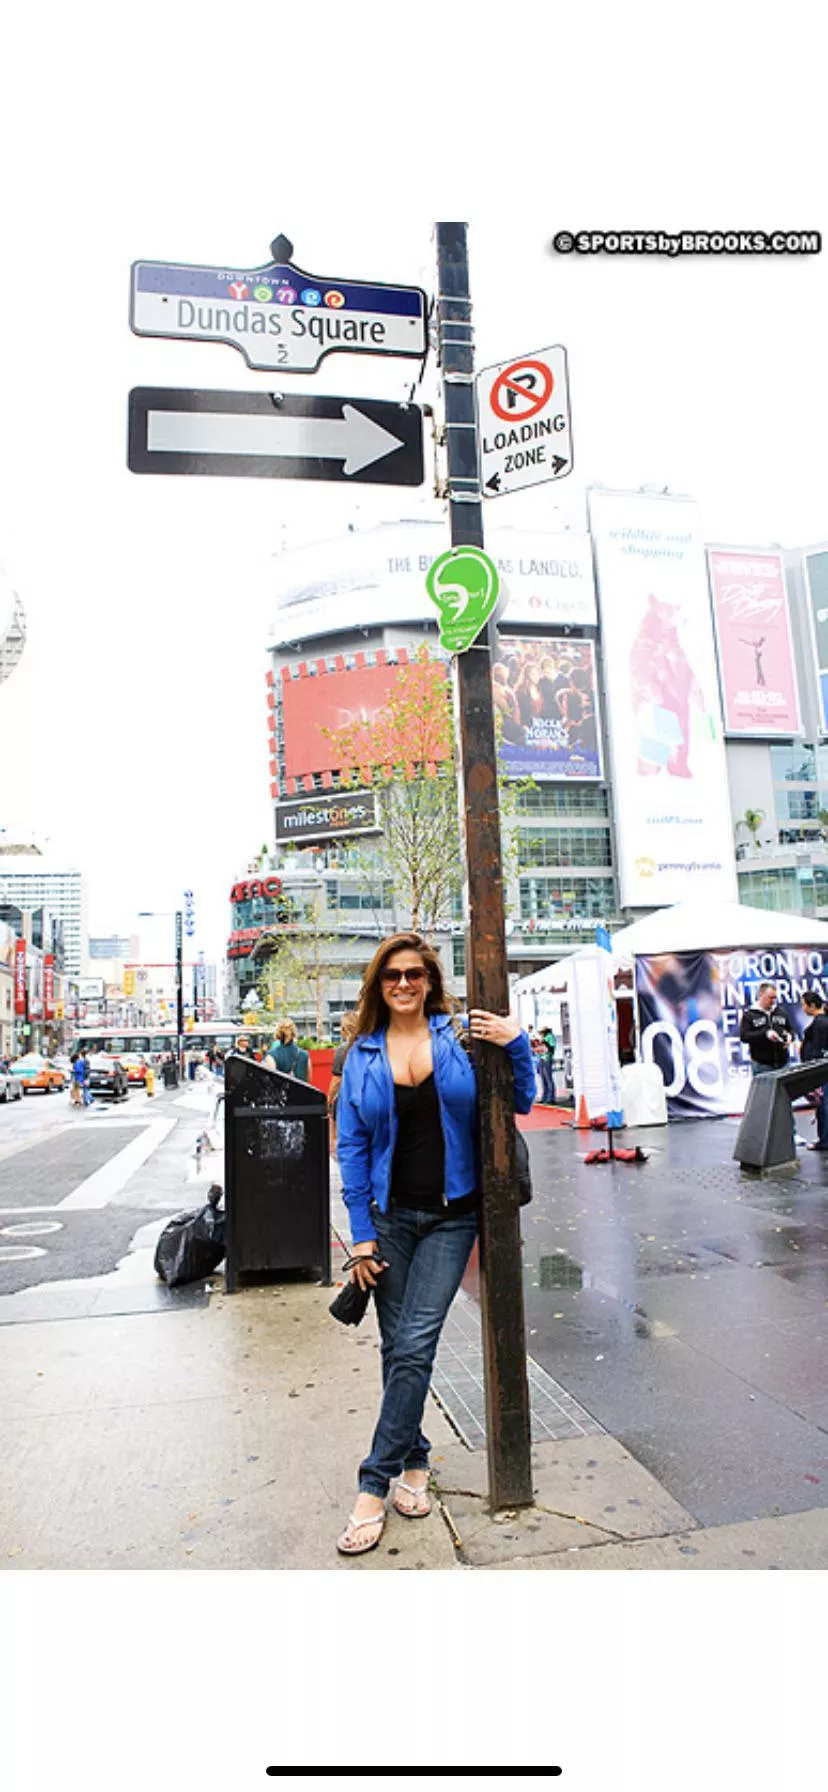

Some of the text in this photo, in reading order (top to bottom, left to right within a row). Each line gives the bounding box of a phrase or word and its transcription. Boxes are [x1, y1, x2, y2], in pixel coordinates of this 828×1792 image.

[177, 299, 386, 346] Dundas Square
[277, 350, 289, 364] 2
[483, 414, 566, 454] LOADING
[504, 445, 547, 474] ZONE
[711, 951, 824, 980] TORONTO
[719, 977, 828, 1007] INTRNA
[641, 1020, 723, 1098] 08
